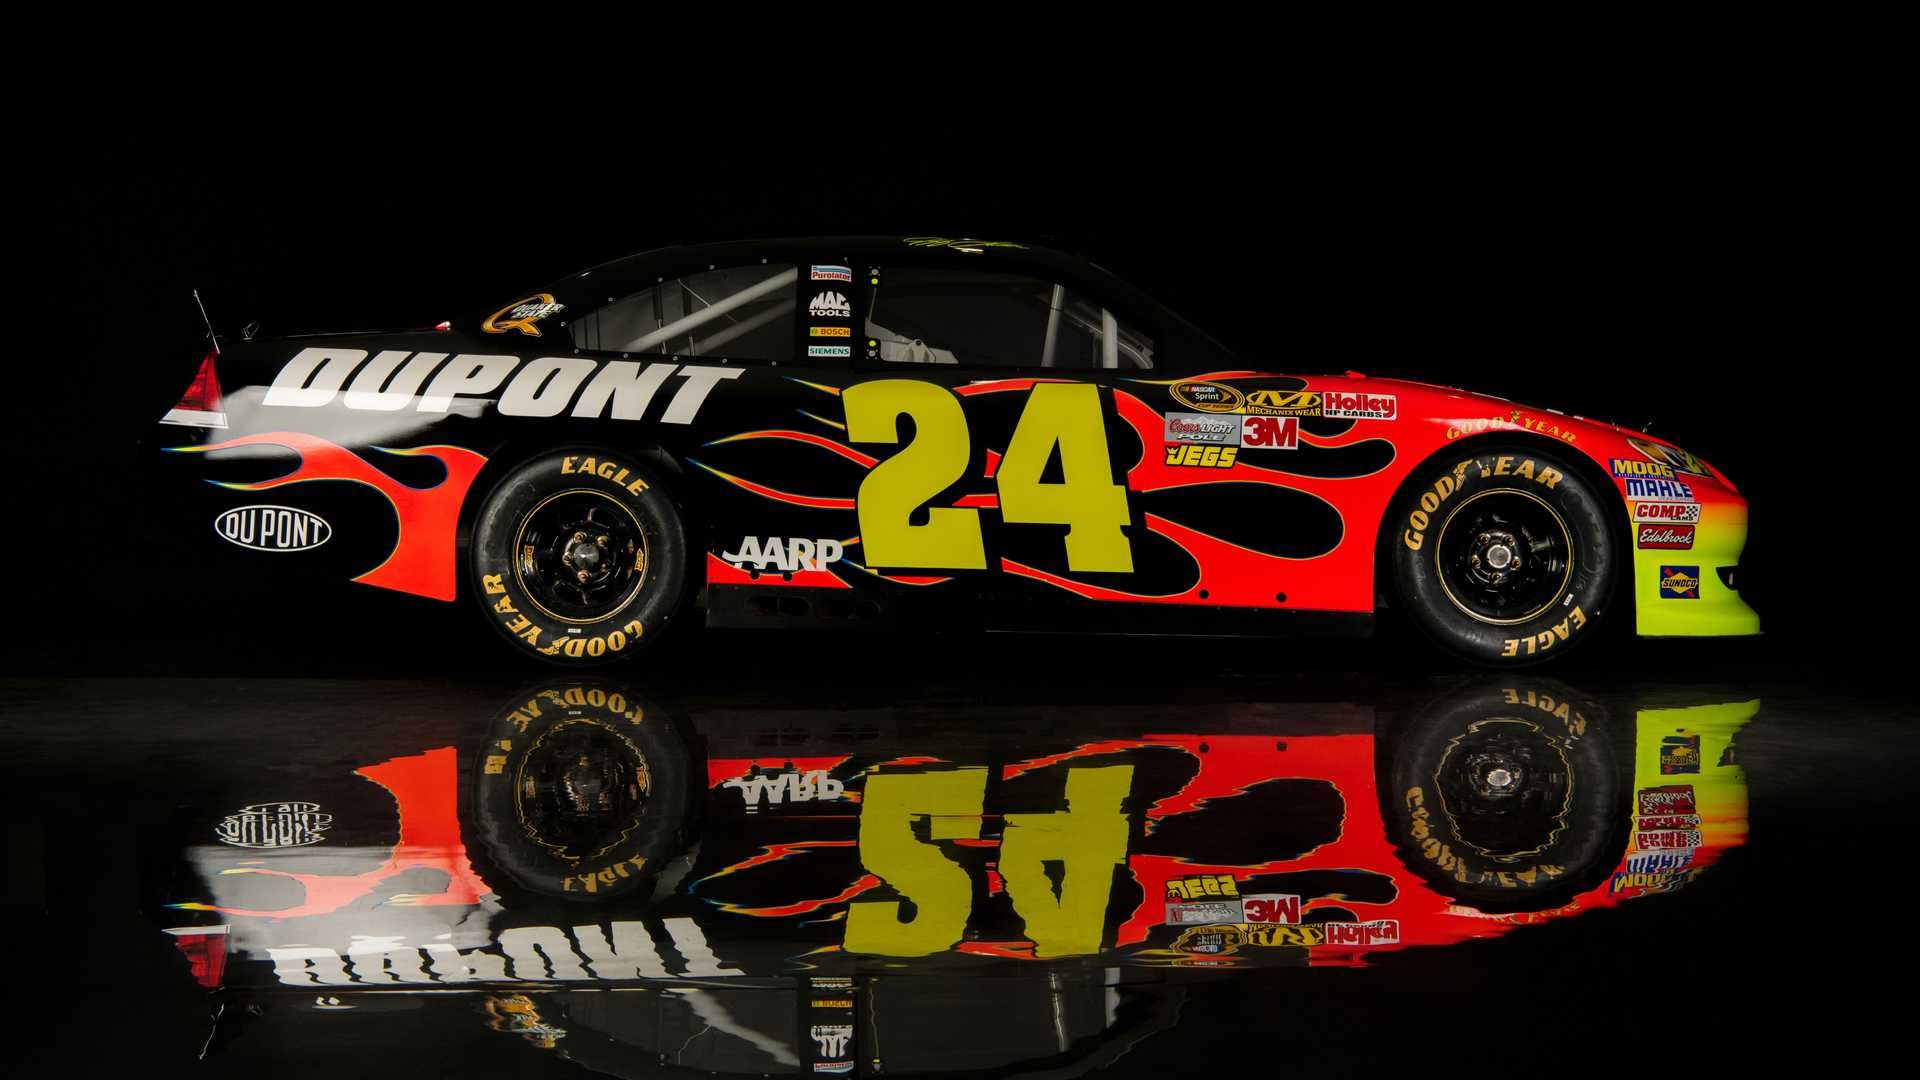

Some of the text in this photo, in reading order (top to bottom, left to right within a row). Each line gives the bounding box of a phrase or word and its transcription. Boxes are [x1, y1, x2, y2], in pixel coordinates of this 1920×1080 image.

[812, 271, 851, 281] Purolator
[809, 291, 851, 310] MAC
[809, 309, 851, 317] TOOLS
[262, 347, 746, 425] DUPONT
[1194, 392, 1220, 401] Sprint
[1325, 392, 1395, 418] Holley
[1246, 406, 1322, 417] MECHANIX WEAR
[1343, 409, 1382, 418] CARBS
[1169, 419, 1236, 434] Coors LIGHT
[1243, 416, 1298, 447] 3M
[1177, 433, 1225, 441] POLE
[1166, 445, 1238, 468] JEGS
[561, 456, 650, 496] EAGLE
[841, 379, 1135, 574] 24
[1613, 459, 1674, 477] MOOG
[1625, 479, 1693, 498] MAHLE
[1637, 504, 1687, 518] COMP
[260, 509, 323, 548] PONT
[1639, 528, 1693, 545] Edelbrock
[722, 535, 843, 571] AARP
[1662, 578, 1698, 588] SUNOCO
[482, 573, 644, 657] GOODYEAR
[1501, 606, 1587, 657] EAGLE
